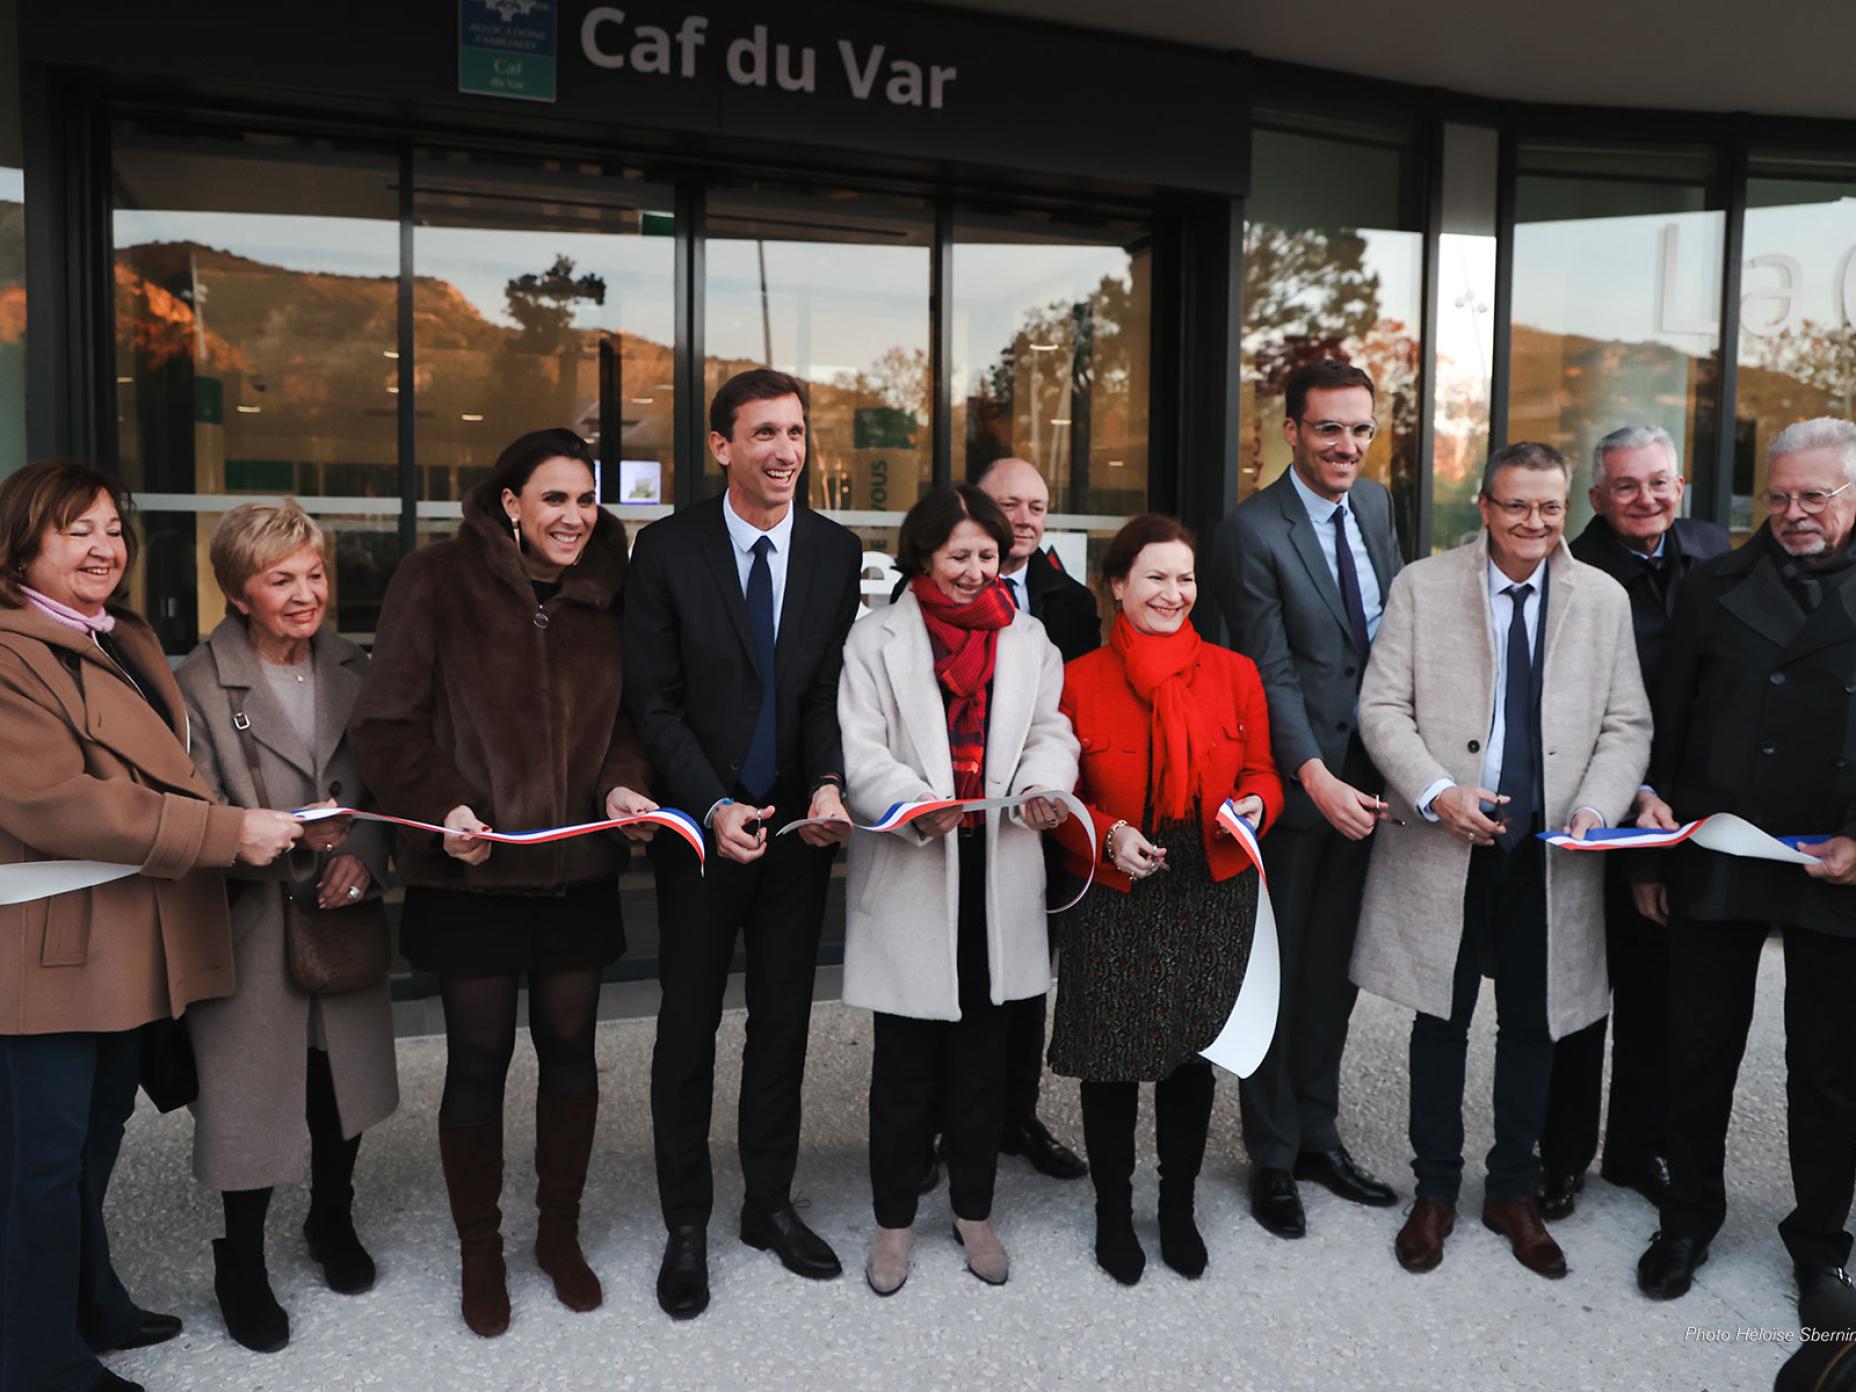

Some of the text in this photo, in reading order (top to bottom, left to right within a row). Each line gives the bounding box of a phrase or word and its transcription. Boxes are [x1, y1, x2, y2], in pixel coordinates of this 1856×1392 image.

[493, 58, 521, 75] Caf
[580, 6, 957, 109] Caf du Var
[1655, 222, 1803, 339] La
